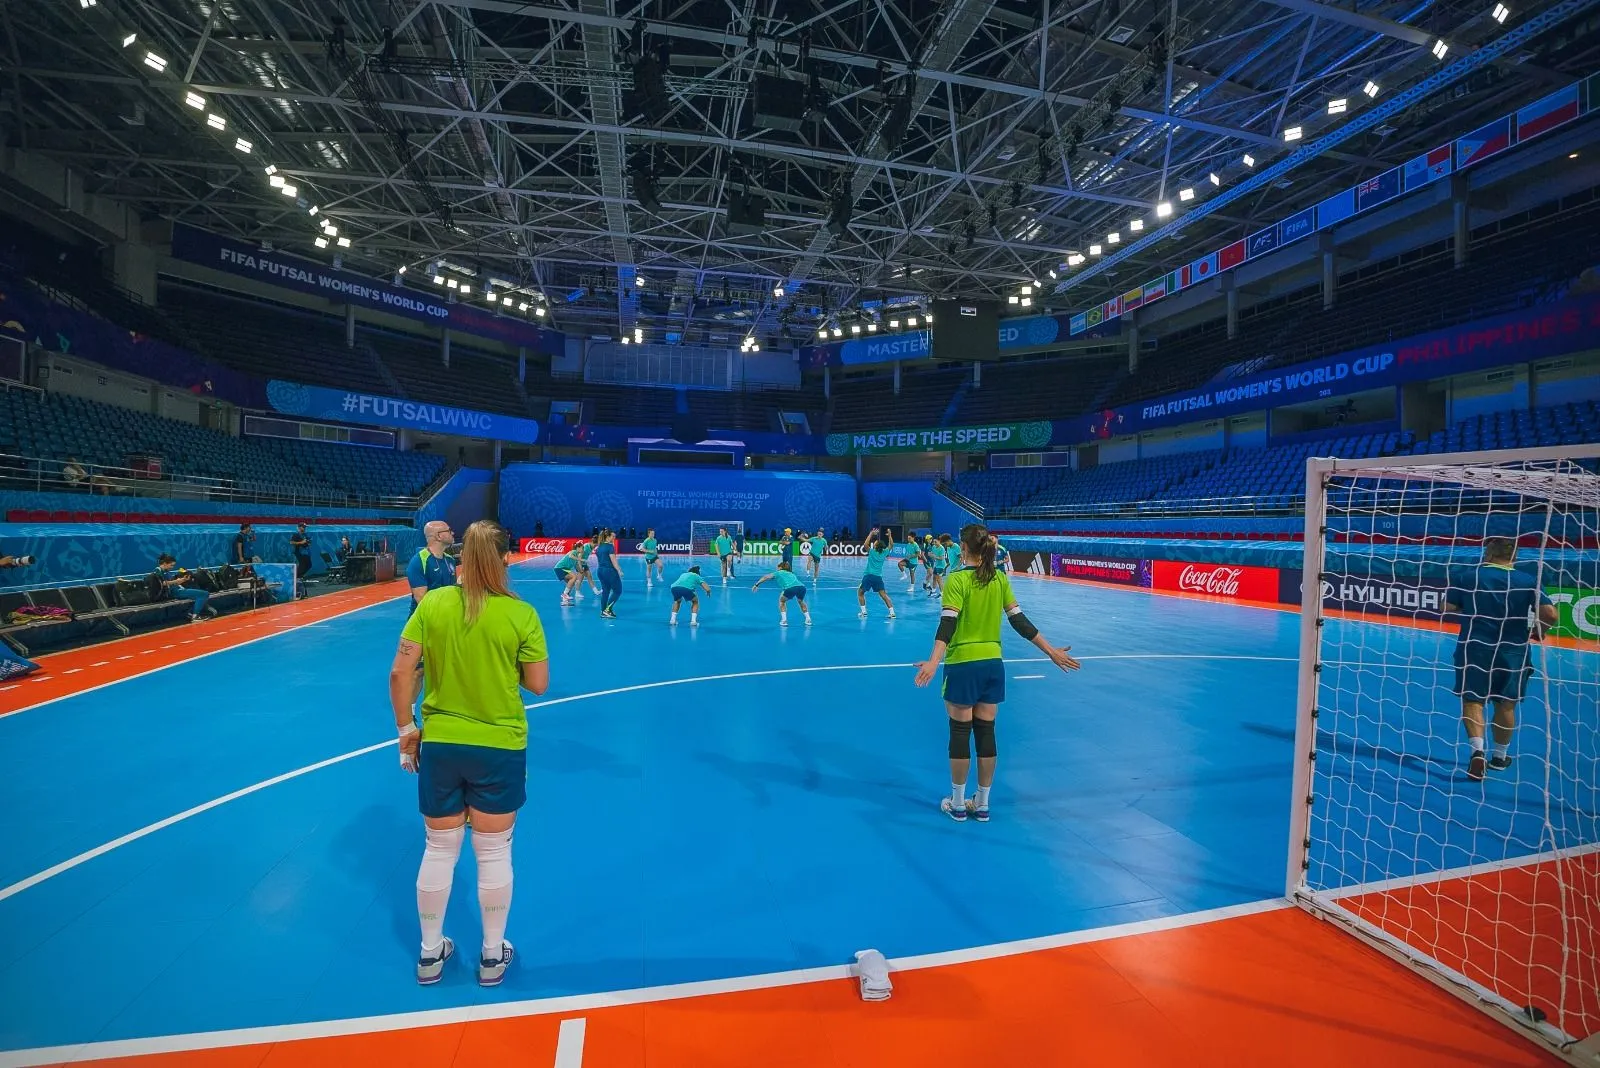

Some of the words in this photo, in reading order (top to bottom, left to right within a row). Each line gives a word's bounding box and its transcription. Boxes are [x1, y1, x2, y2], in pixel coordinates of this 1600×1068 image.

[1286, 219, 1308, 236] FIFA
[220, 248, 257, 269] FIFA
[259, 259, 316, 285] FUTSAL
[318, 275, 380, 301] WOMEN'S
[382, 292, 425, 312] WORLD
[426, 304, 449, 318] CUP
[867, 338, 928, 357] MASTER
[1142, 405, 1166, 420] FIFA
[1167, 394, 1213, 414] FUTSAL
[1215, 377, 1282, 404] WOMEN'S
[1285, 363, 1349, 390] WORLD
[1352, 353, 1394, 375] CUP
[341, 393, 492, 431] #FUTSALWWC
[853, 432, 917, 448] MASTER
[919, 430, 953, 446] THE
[955, 427, 1011, 443] SPEED
[647, 498, 729, 509] PHILIPPINES
[731, 500, 761, 510] 2025
[656, 490, 687, 498] FUTSAL
[1382, 521, 1395, 529] 101
[1125, 563, 1137, 571] CUP
[1179, 564, 1243, 595] Coca-Cola
[1340, 583, 1446, 609] HYUNDA
